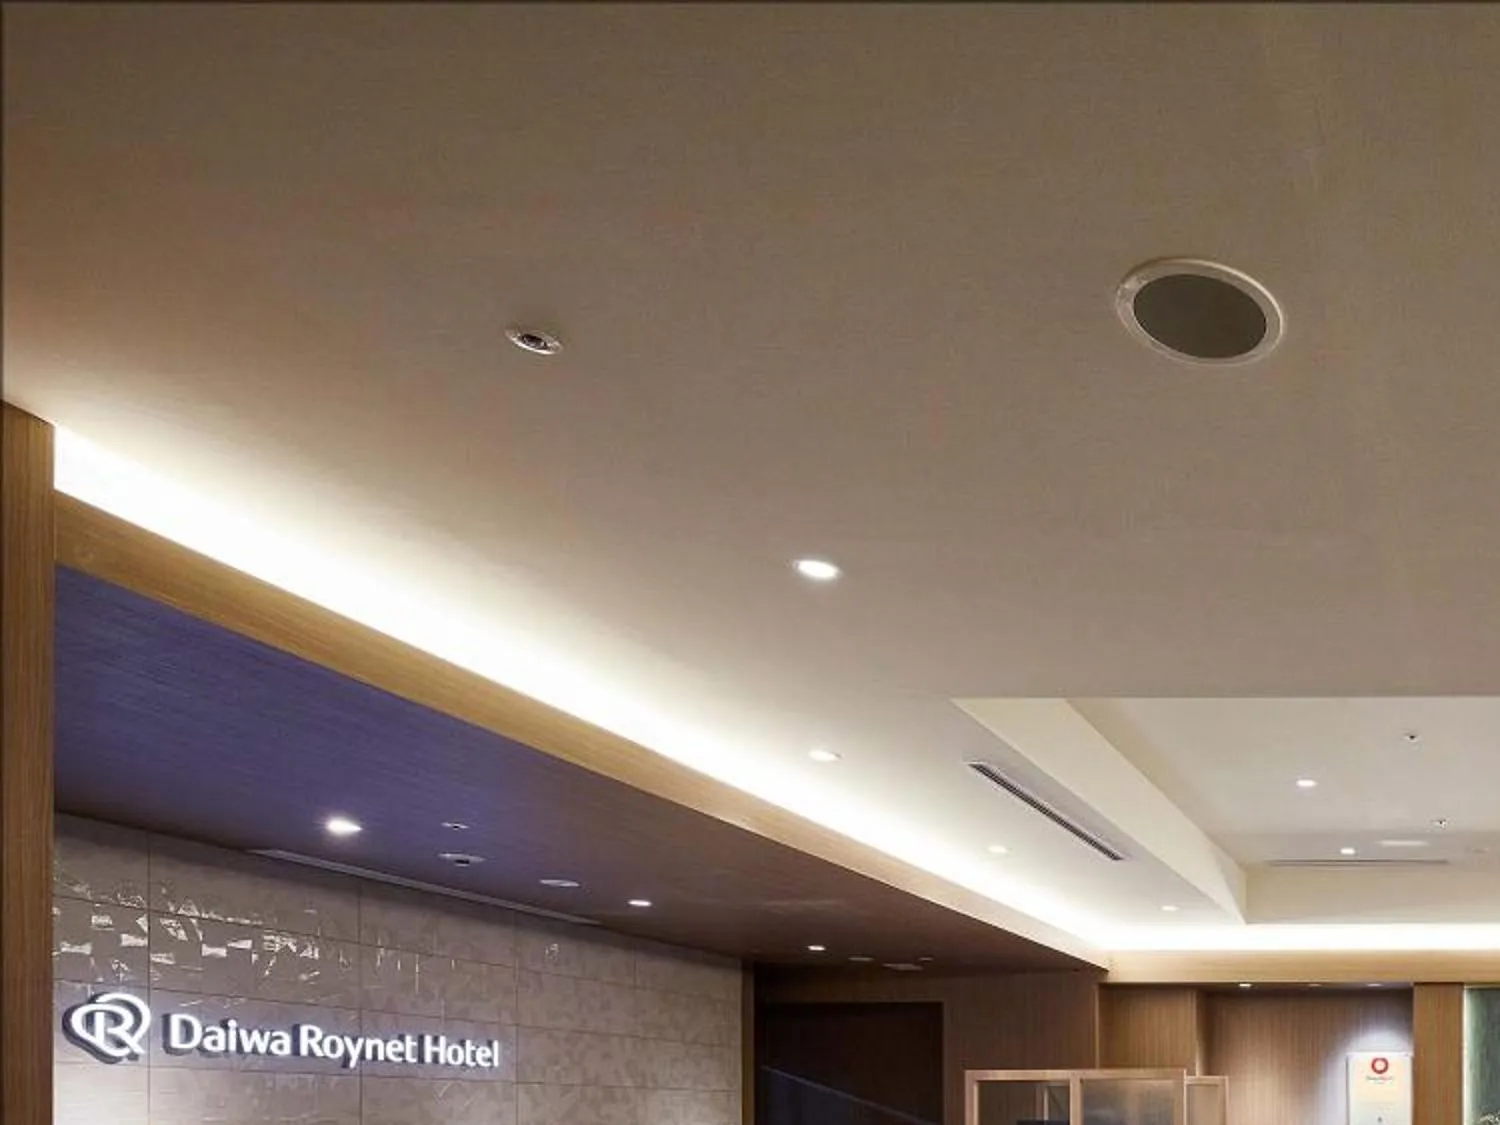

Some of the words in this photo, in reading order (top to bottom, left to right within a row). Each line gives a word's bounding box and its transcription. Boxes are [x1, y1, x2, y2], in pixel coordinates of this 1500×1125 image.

[165, 1013, 291, 1056] Daiwa
[299, 1023, 418, 1069] Roynet
[424, 1034, 500, 1069] Hotel
